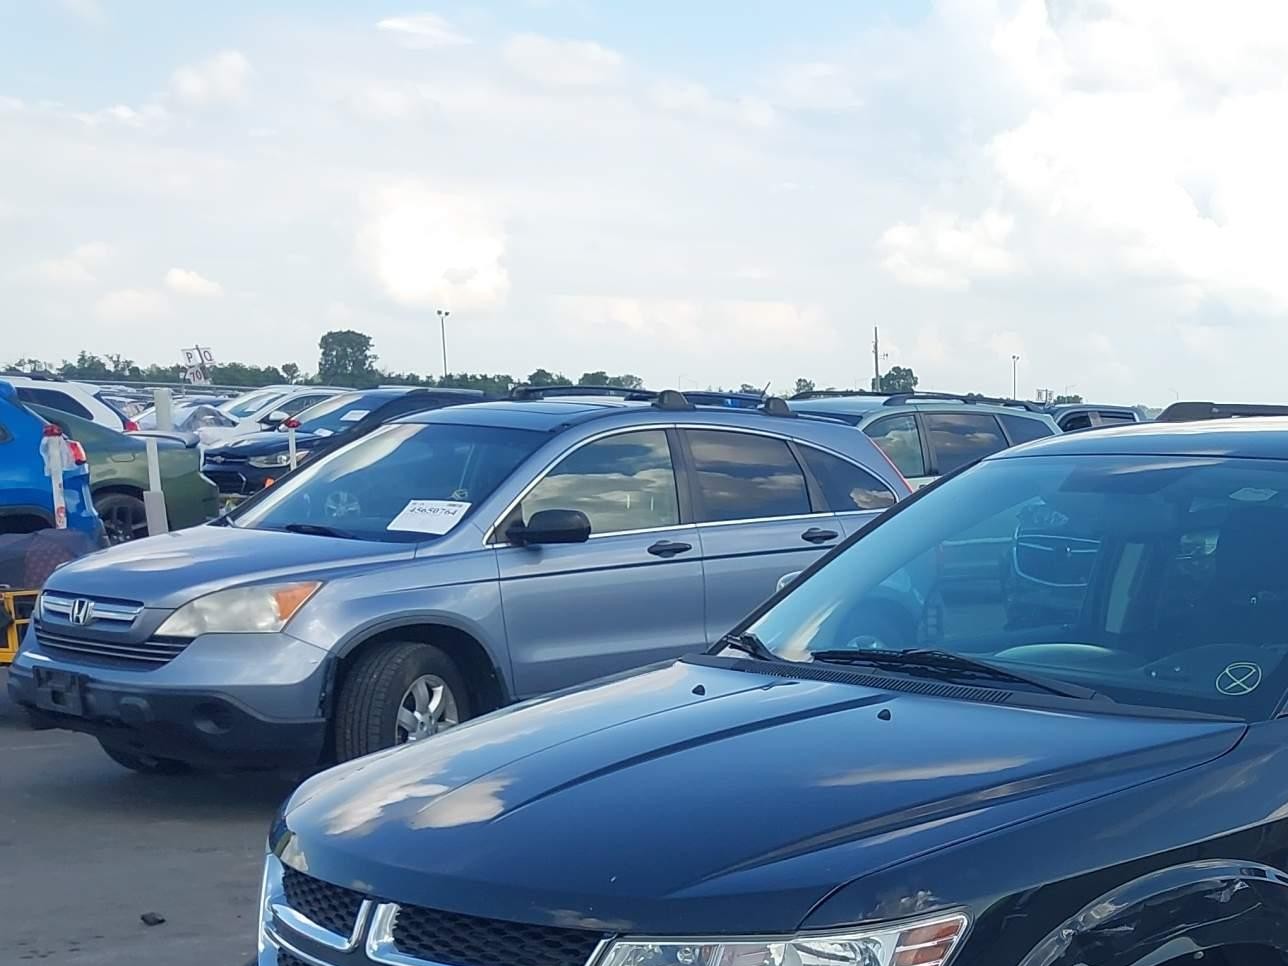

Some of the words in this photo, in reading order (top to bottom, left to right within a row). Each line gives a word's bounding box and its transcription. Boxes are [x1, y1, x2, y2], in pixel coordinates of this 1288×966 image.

[186, 352, 193, 363] P
[203, 350, 214, 362] Q
[190, 369, 202, 382] 70
